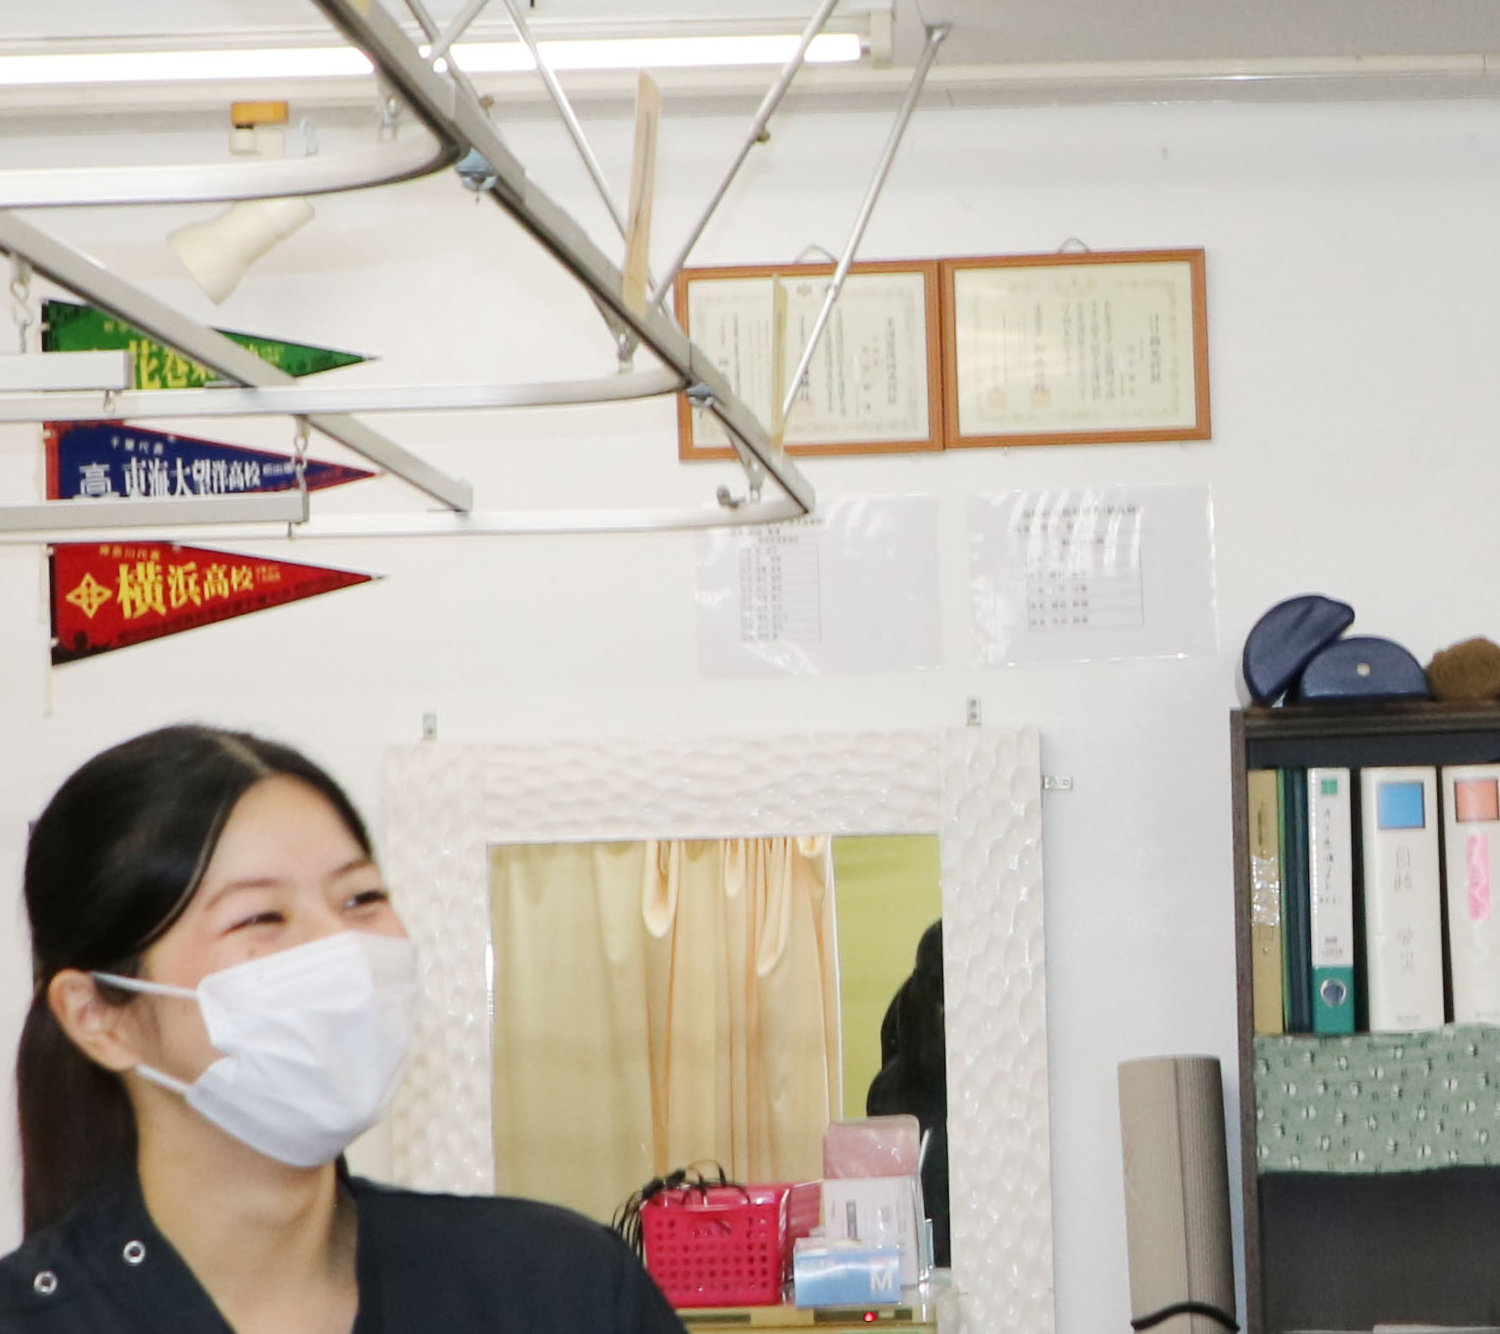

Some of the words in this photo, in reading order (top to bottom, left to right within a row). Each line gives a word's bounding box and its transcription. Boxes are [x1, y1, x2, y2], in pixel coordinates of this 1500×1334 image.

[117, 560, 255, 620] 横浜高校
[869, 1265, 893, 1292] M
